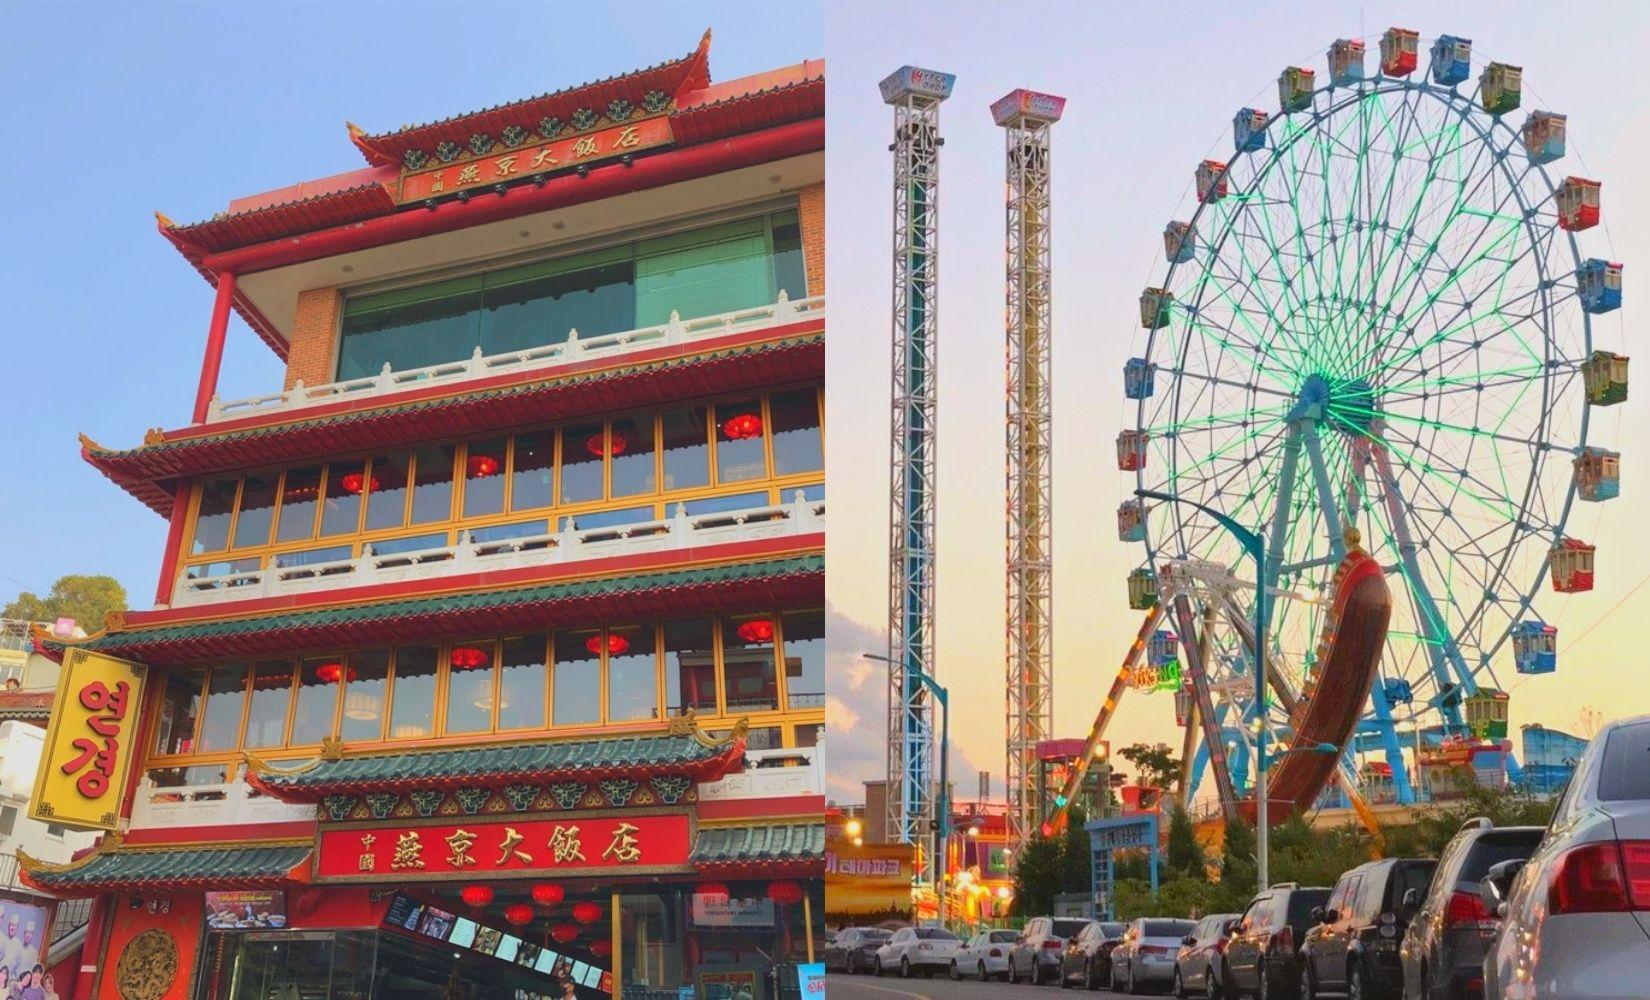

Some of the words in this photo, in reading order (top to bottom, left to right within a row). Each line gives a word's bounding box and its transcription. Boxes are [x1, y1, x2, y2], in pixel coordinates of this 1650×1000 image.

[431, 171, 444, 192] 中國
[456, 126, 641, 185] 燕京大飯店
[61, 681, 130, 799] 연경
[359, 833, 377, 872] 中國
[390, 822, 642, 870] 燕京大飯店
[147, 899, 171, 914] 연경
